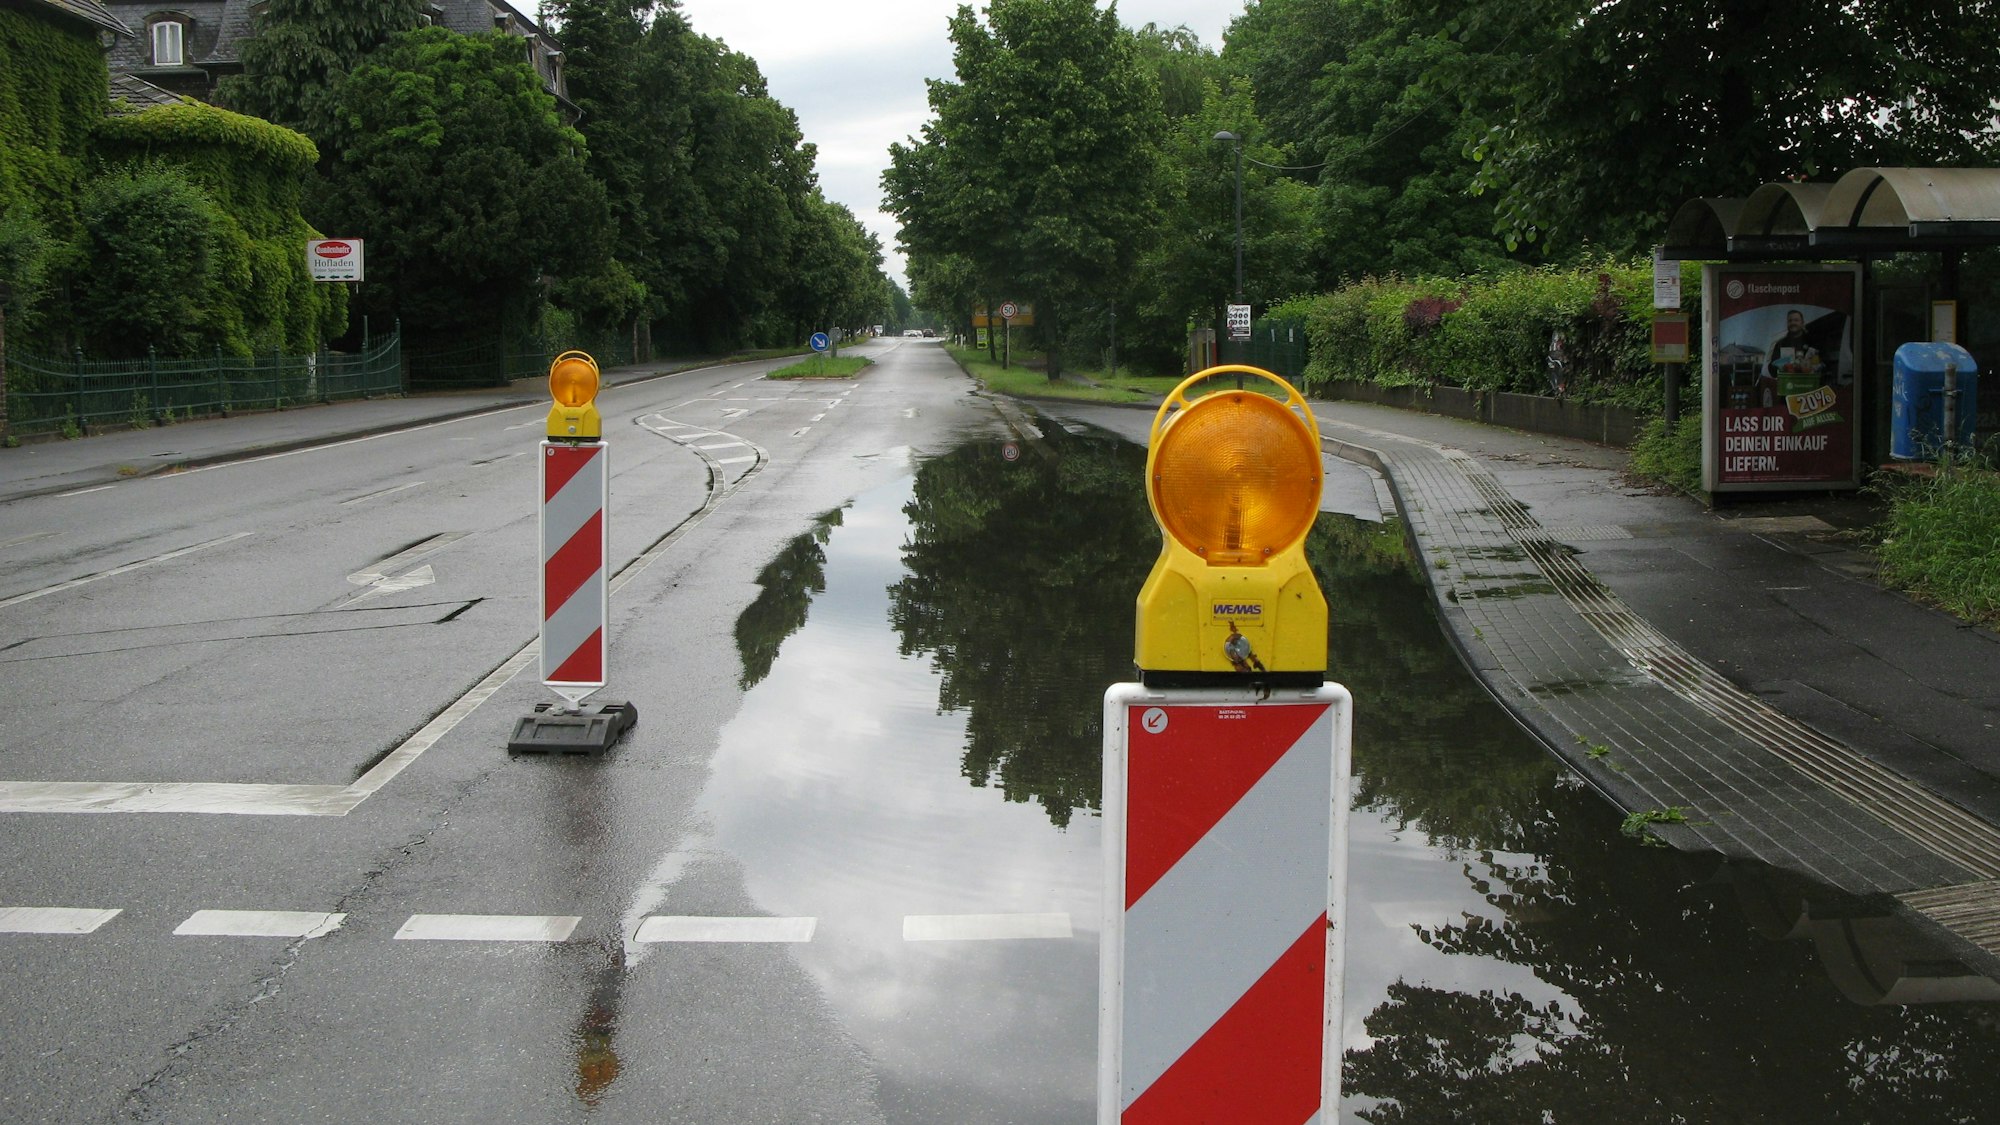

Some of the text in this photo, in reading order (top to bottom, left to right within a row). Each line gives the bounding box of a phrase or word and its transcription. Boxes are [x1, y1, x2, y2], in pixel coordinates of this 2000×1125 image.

[314, 259, 354, 267] Hofladen
[1748, 284, 1800, 294] flaschenpost
[1797, 390, 1832, 414] 20%
[1725, 416, 1784, 432] LASS DIR
[1725, 435, 1828, 452] DEINEN EINKAUF
[1725, 455, 1780, 472] LIEFERN.
[1213, 604, 1262, 615] WEMAS
